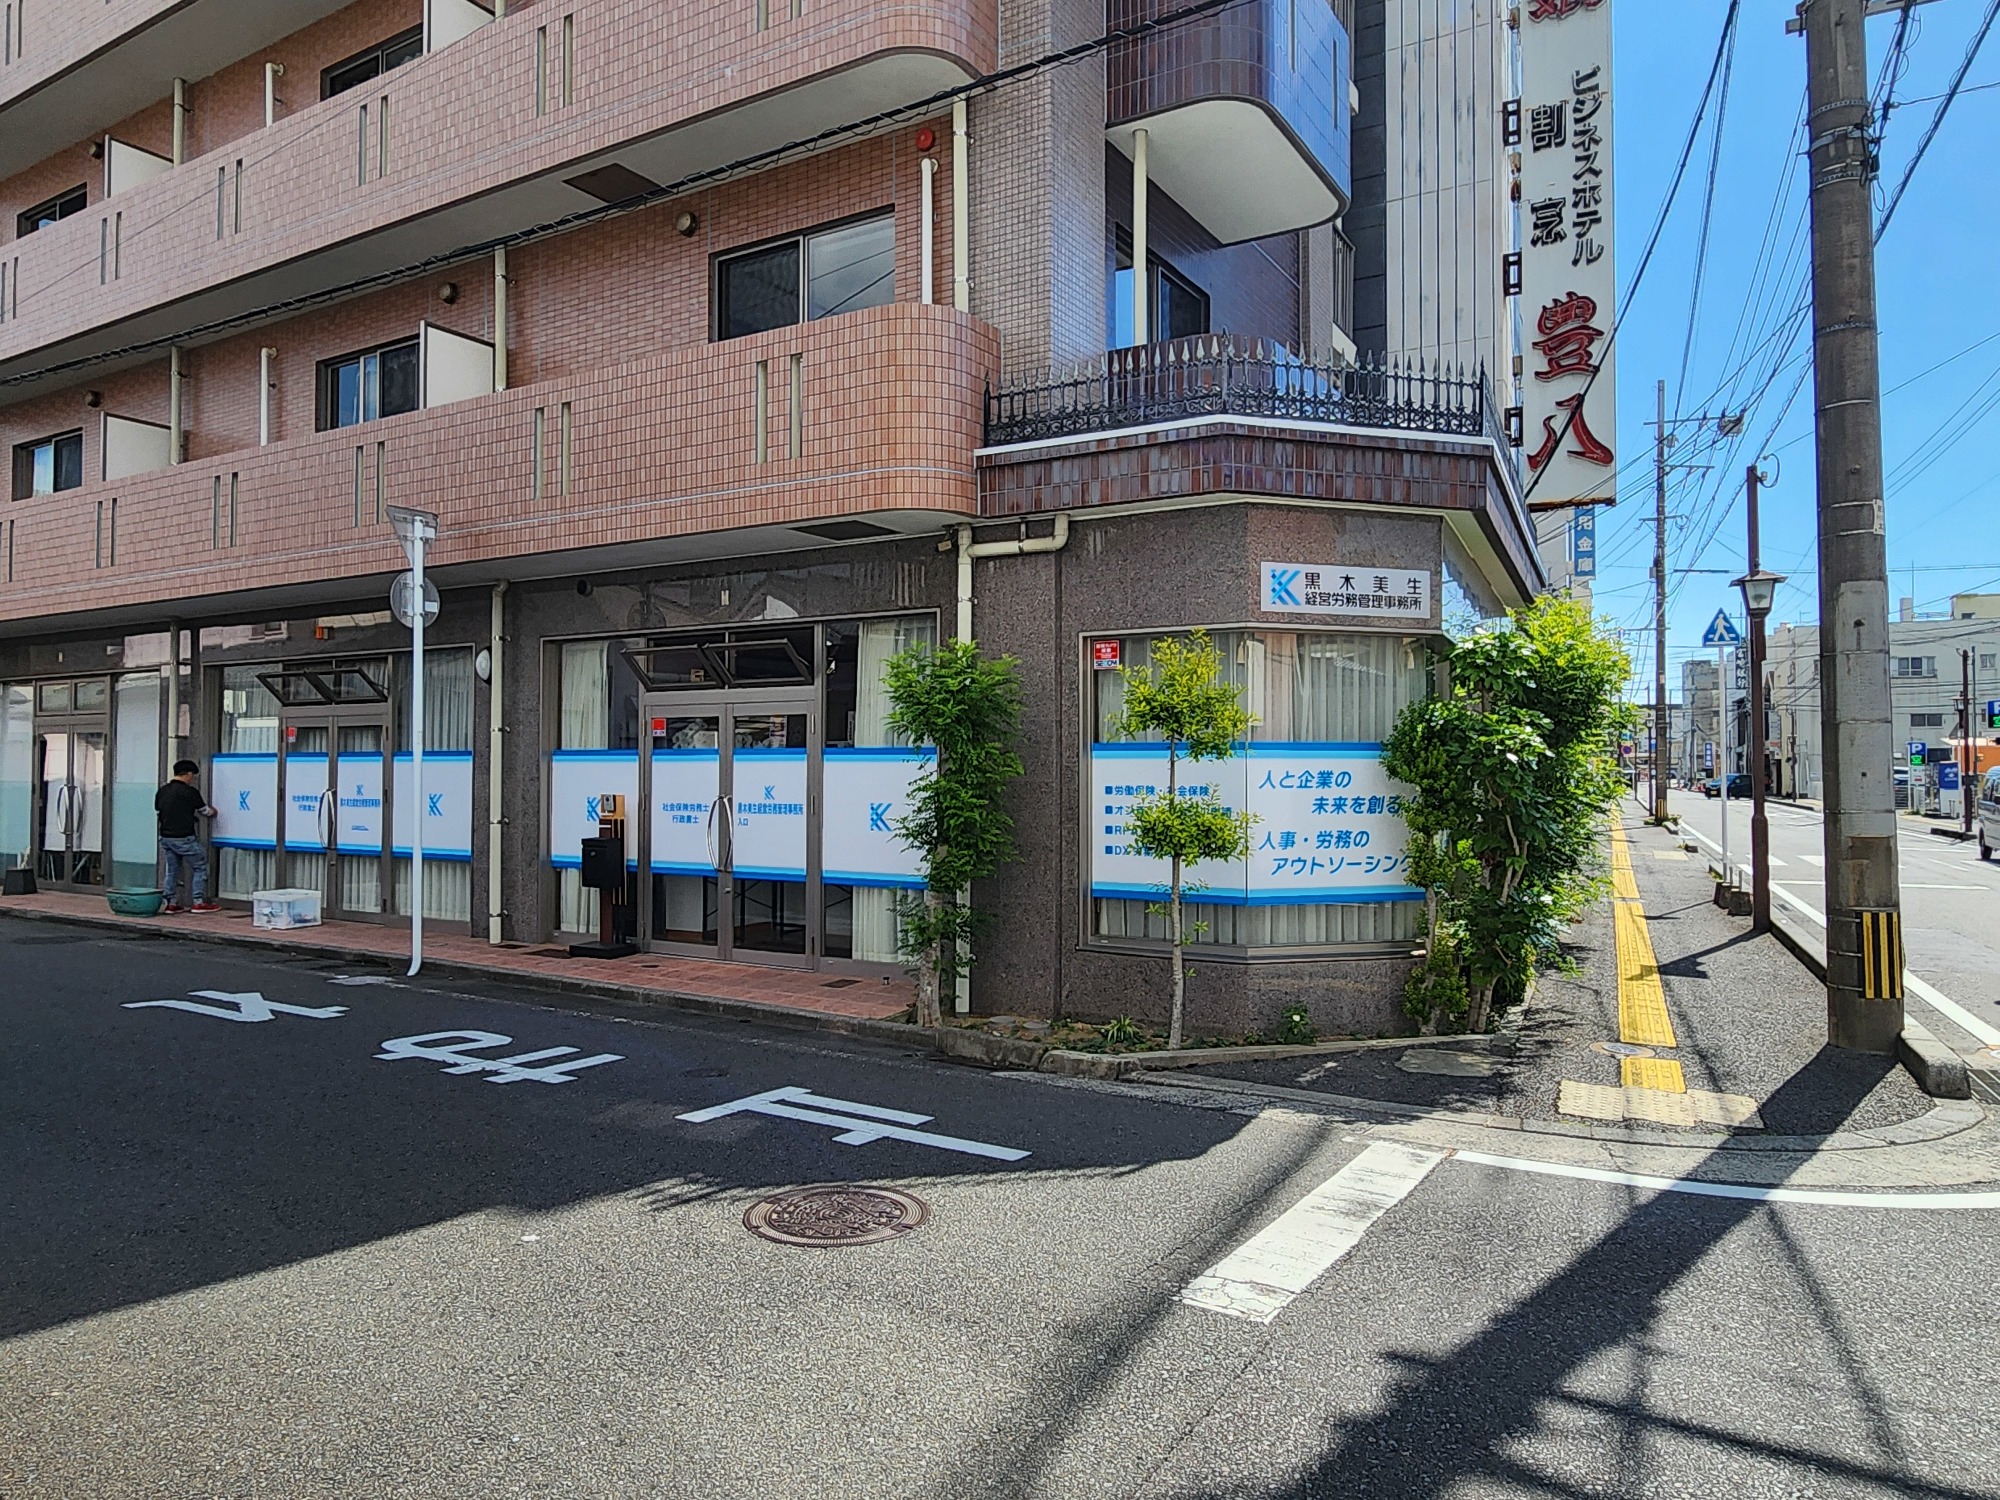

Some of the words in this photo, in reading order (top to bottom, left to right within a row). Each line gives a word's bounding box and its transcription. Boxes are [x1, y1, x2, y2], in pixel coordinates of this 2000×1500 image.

[1571, 64, 1603, 267] ビジネスホテル
[1576, 506, 1594, 572] 用金庫
[1304, 572, 1423, 595] 黒木美生
[1304, 591, 1423, 611] 経営労務管理事務所
[1911, 743, 1923, 754] P
[1258, 769, 1352, 790] 人と企業の
[1311, 795, 1417, 815] 未来を創る
[1258, 830, 1370, 850] 人事・労務の
